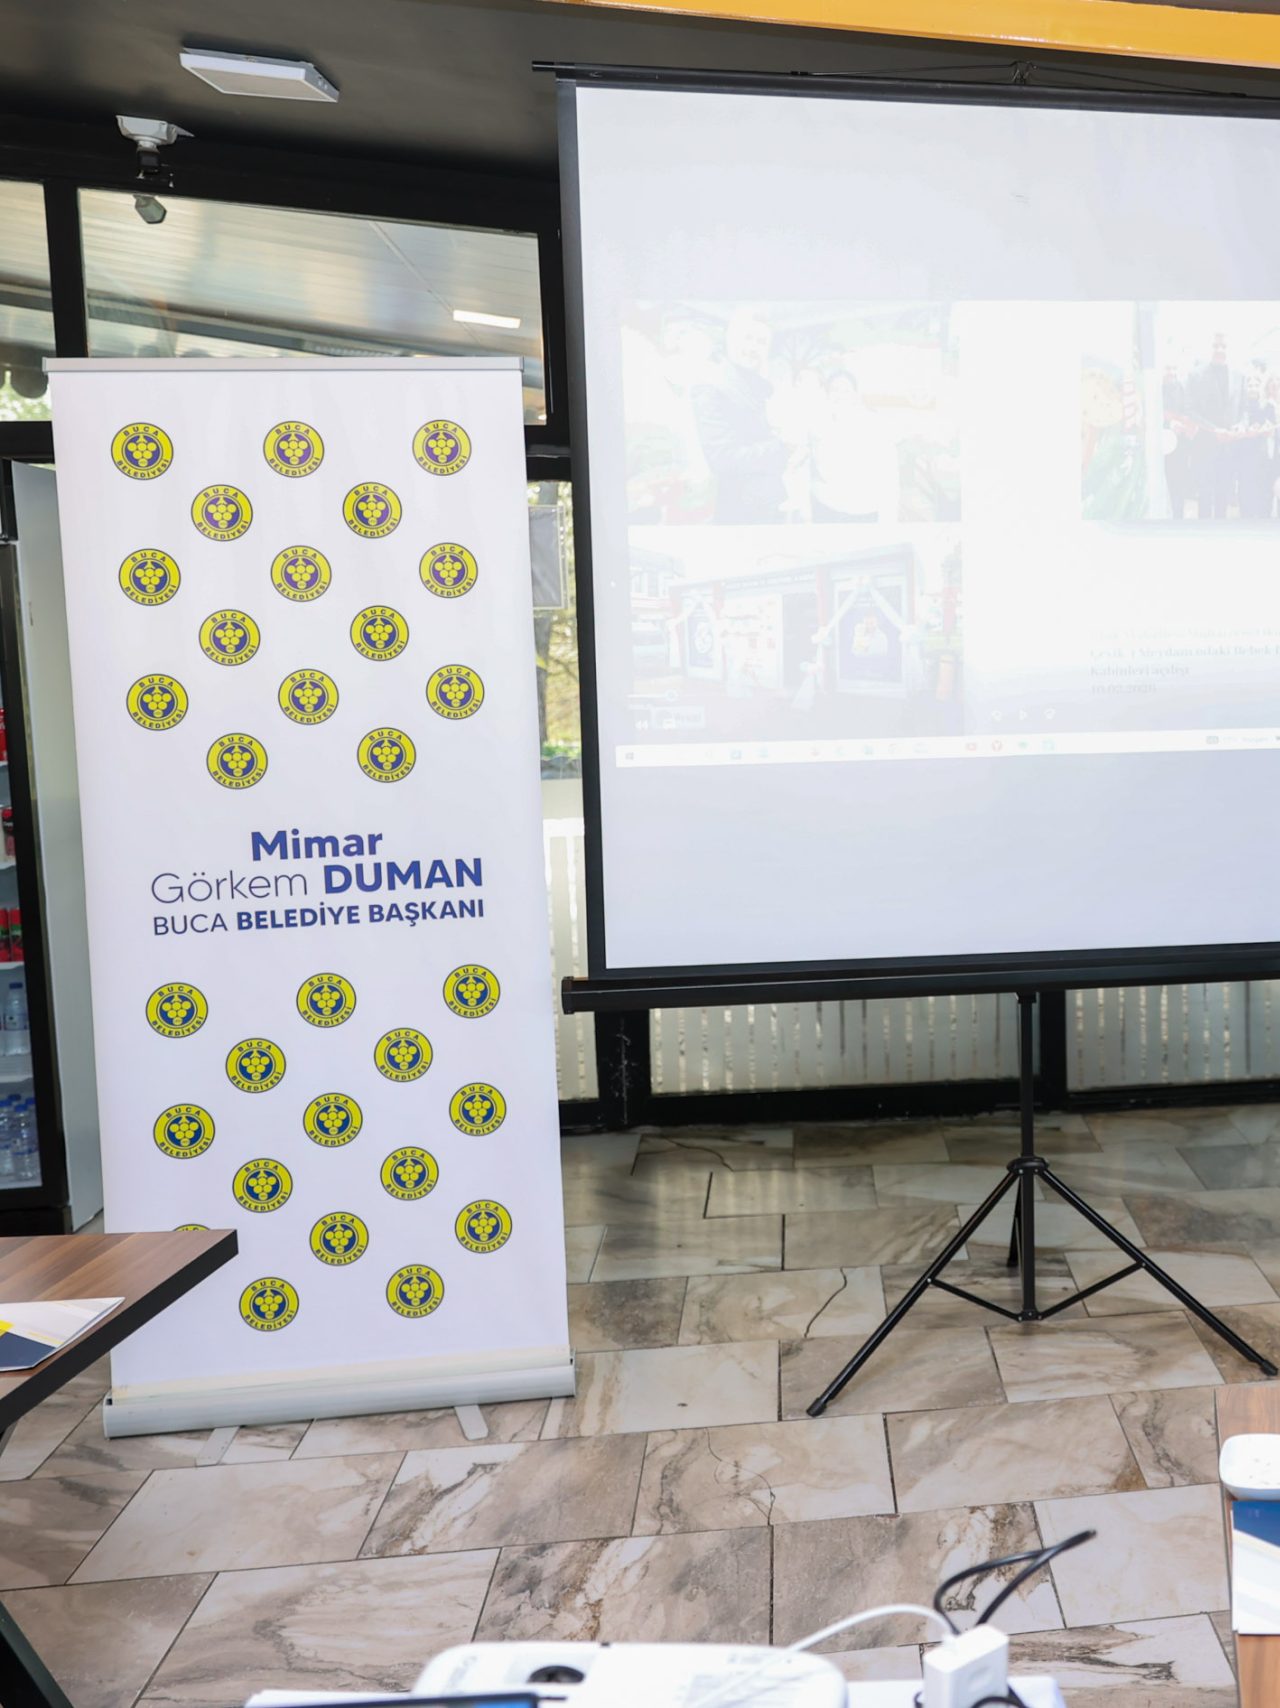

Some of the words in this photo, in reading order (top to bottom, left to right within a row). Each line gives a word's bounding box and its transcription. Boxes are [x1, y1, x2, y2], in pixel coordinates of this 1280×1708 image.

[122, 426, 159, 438] BUCA
[275, 424, 310, 436] BUCA
[424, 423, 457, 434] BUCA
[202, 488, 239, 500] BUCA
[354, 486, 389, 497] BUCA
[282, 549, 318, 560] BUCA
[431, 546, 464, 557] BUCA
[130, 552, 166, 564] BUCA
[210, 613, 246, 625] BUCA
[361, 609, 396, 620] BUCA
[289, 672, 325, 684] BUCA
[437, 668, 471, 679] BUCA
[138, 677, 174, 689] BUCA
[218, 736, 254, 748] BUCA
[368, 731, 403, 742] BUCA
[251, 829, 383, 861] Mimar
[151, 870, 308, 904] Görkem
[323, 858, 483, 894] DUMAN
[154, 913, 228, 936] BUCA
[236, 901, 361, 931] BELEDİYE
[368, 898, 484, 927] BAŞKANI
[454, 968, 487, 979] BUCA
[307, 976, 342, 987] BUCA
[157, 986, 194, 997] BUCA
[385, 1031, 420, 1042] BUCA
[237, 1041, 272, 1052] BUCA
[460, 1086, 493, 1097] BUCA
[314, 1096, 350, 1107] BUCA
[164, 1107, 201, 1118] BUCA
[391, 1150, 426, 1161] BUCA
[243, 1161, 279, 1172] BUCA
[466, 1203, 499, 1214] BUCA
[321, 1215, 356, 1226] BUCA
[397, 1268, 431, 1279] BUCA
[250, 1280, 286, 1291] BUCA
